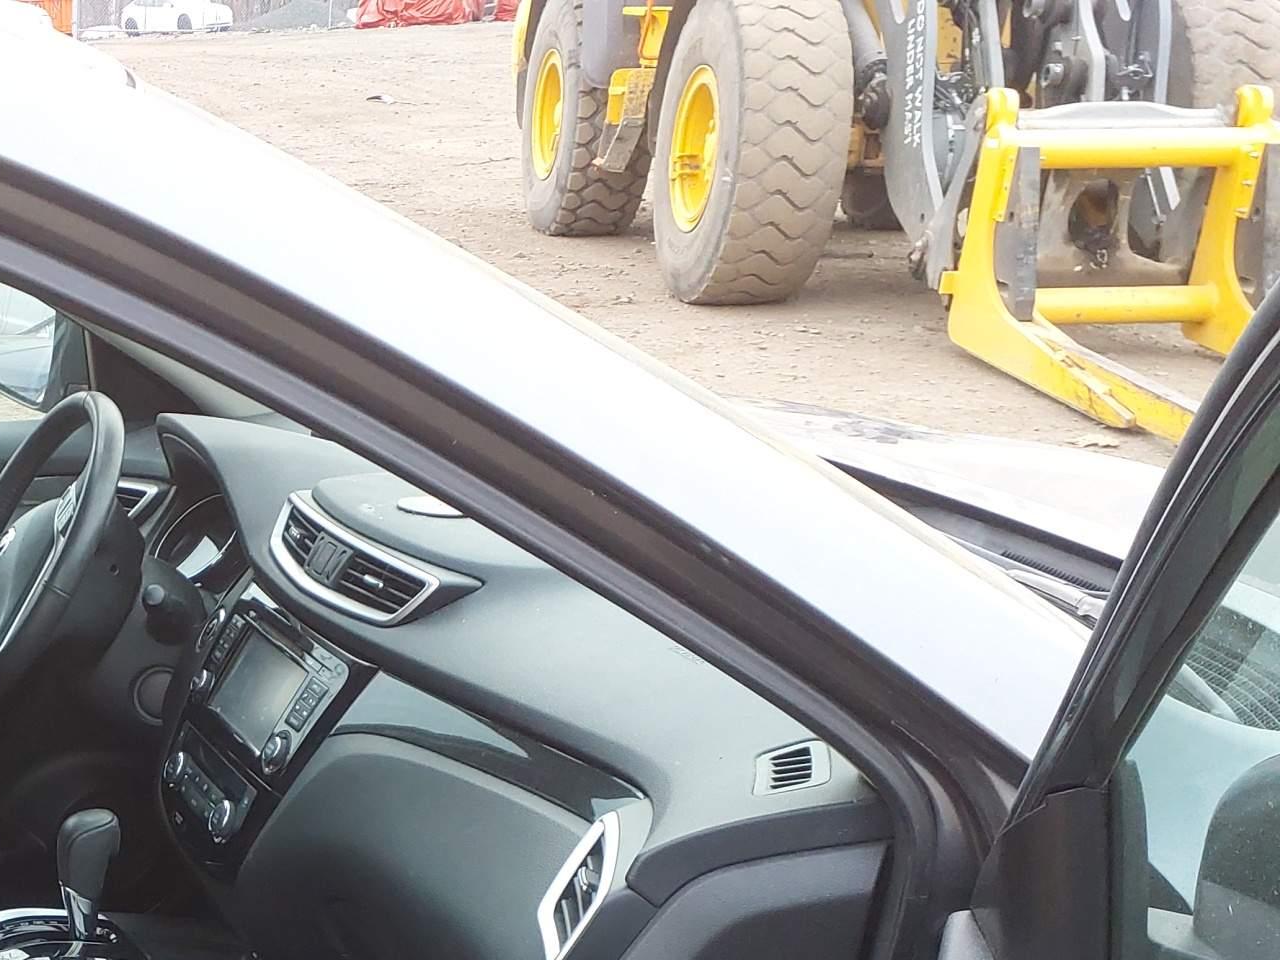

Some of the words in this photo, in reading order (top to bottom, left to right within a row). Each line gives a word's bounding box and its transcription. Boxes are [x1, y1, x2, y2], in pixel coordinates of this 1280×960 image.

[905, 18, 916, 90] UNDER
[915, 36, 924, 80] NOT
[912, 86, 923, 148] WALK
